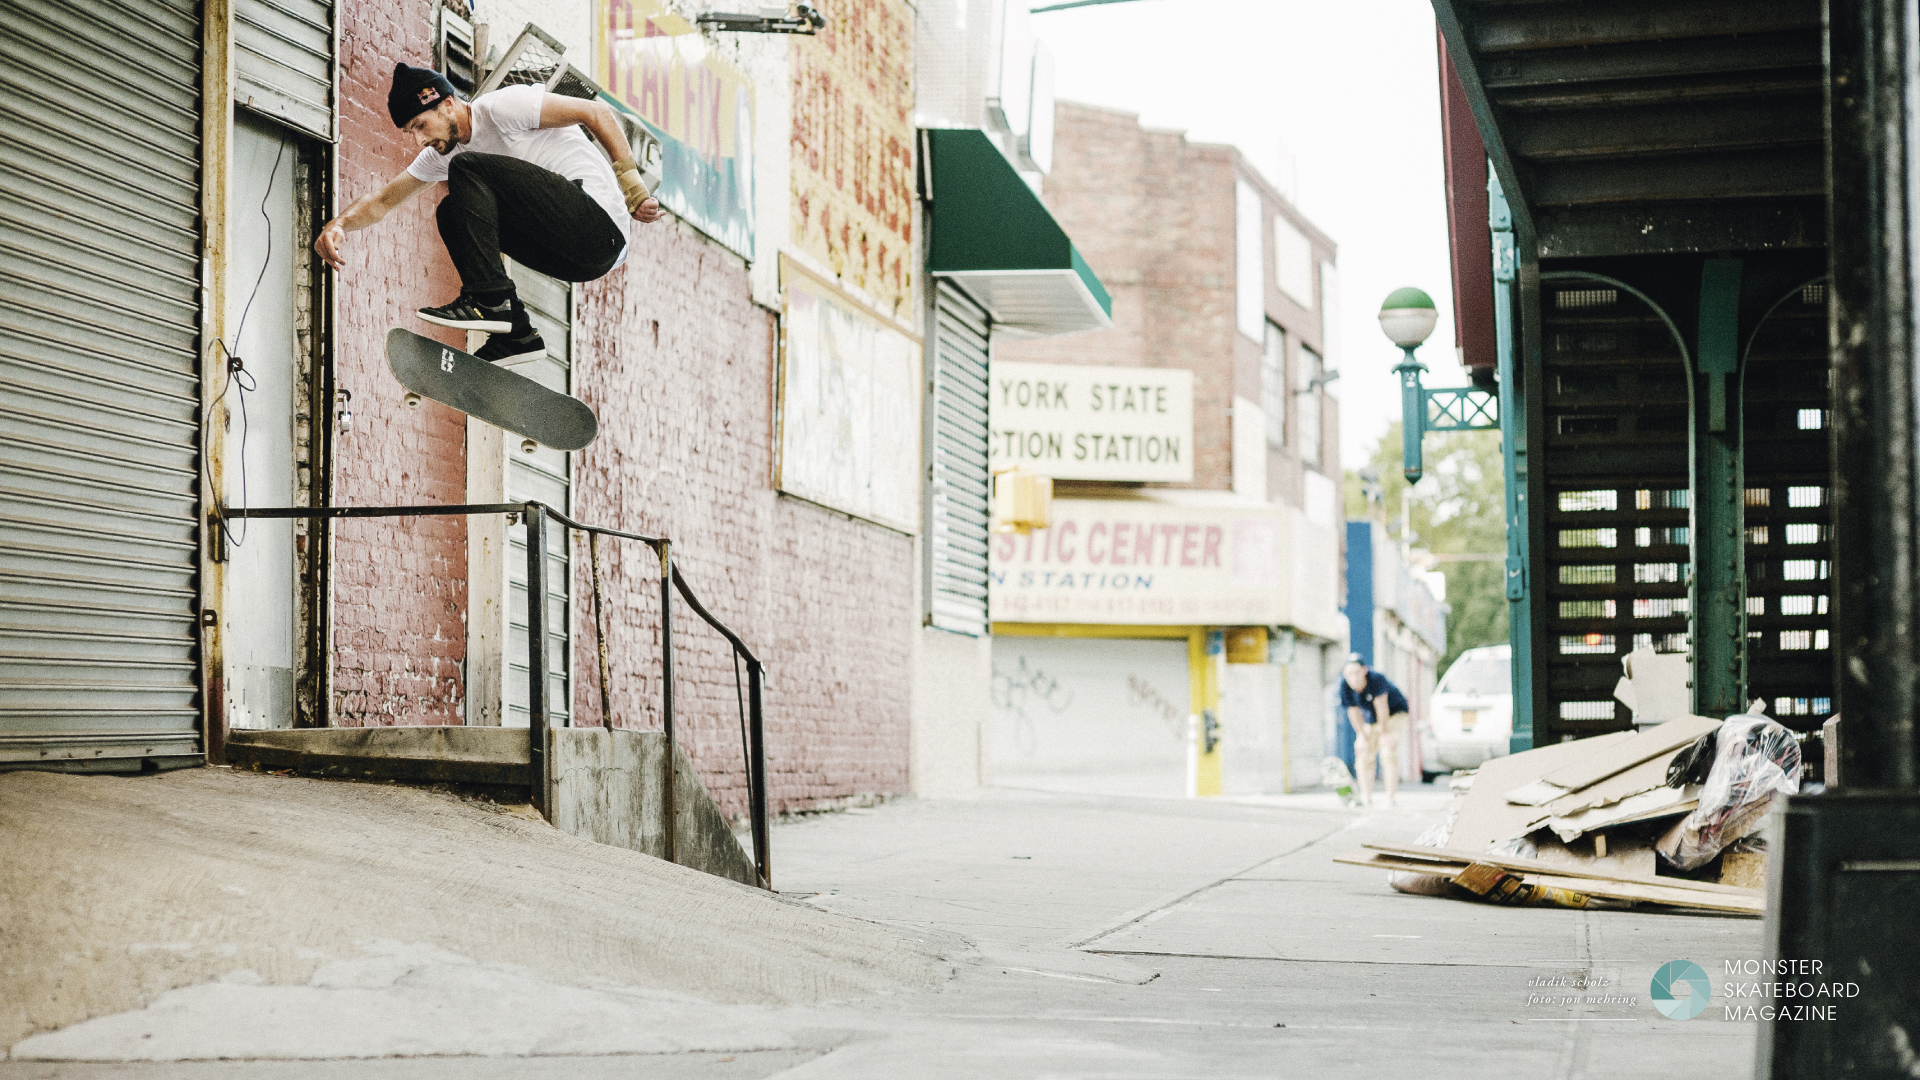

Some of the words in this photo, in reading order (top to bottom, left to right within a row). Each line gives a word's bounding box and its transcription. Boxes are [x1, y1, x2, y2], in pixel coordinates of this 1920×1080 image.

[684, 58, 723, 173] FIX
[999, 379, 1069, 409] YORK
[1090, 384, 1168, 414] STATE
[1073, 434, 1181, 463] STATION
[1086, 521, 1224, 568] CENTER
[1019, 572, 1153, 590] STATION
